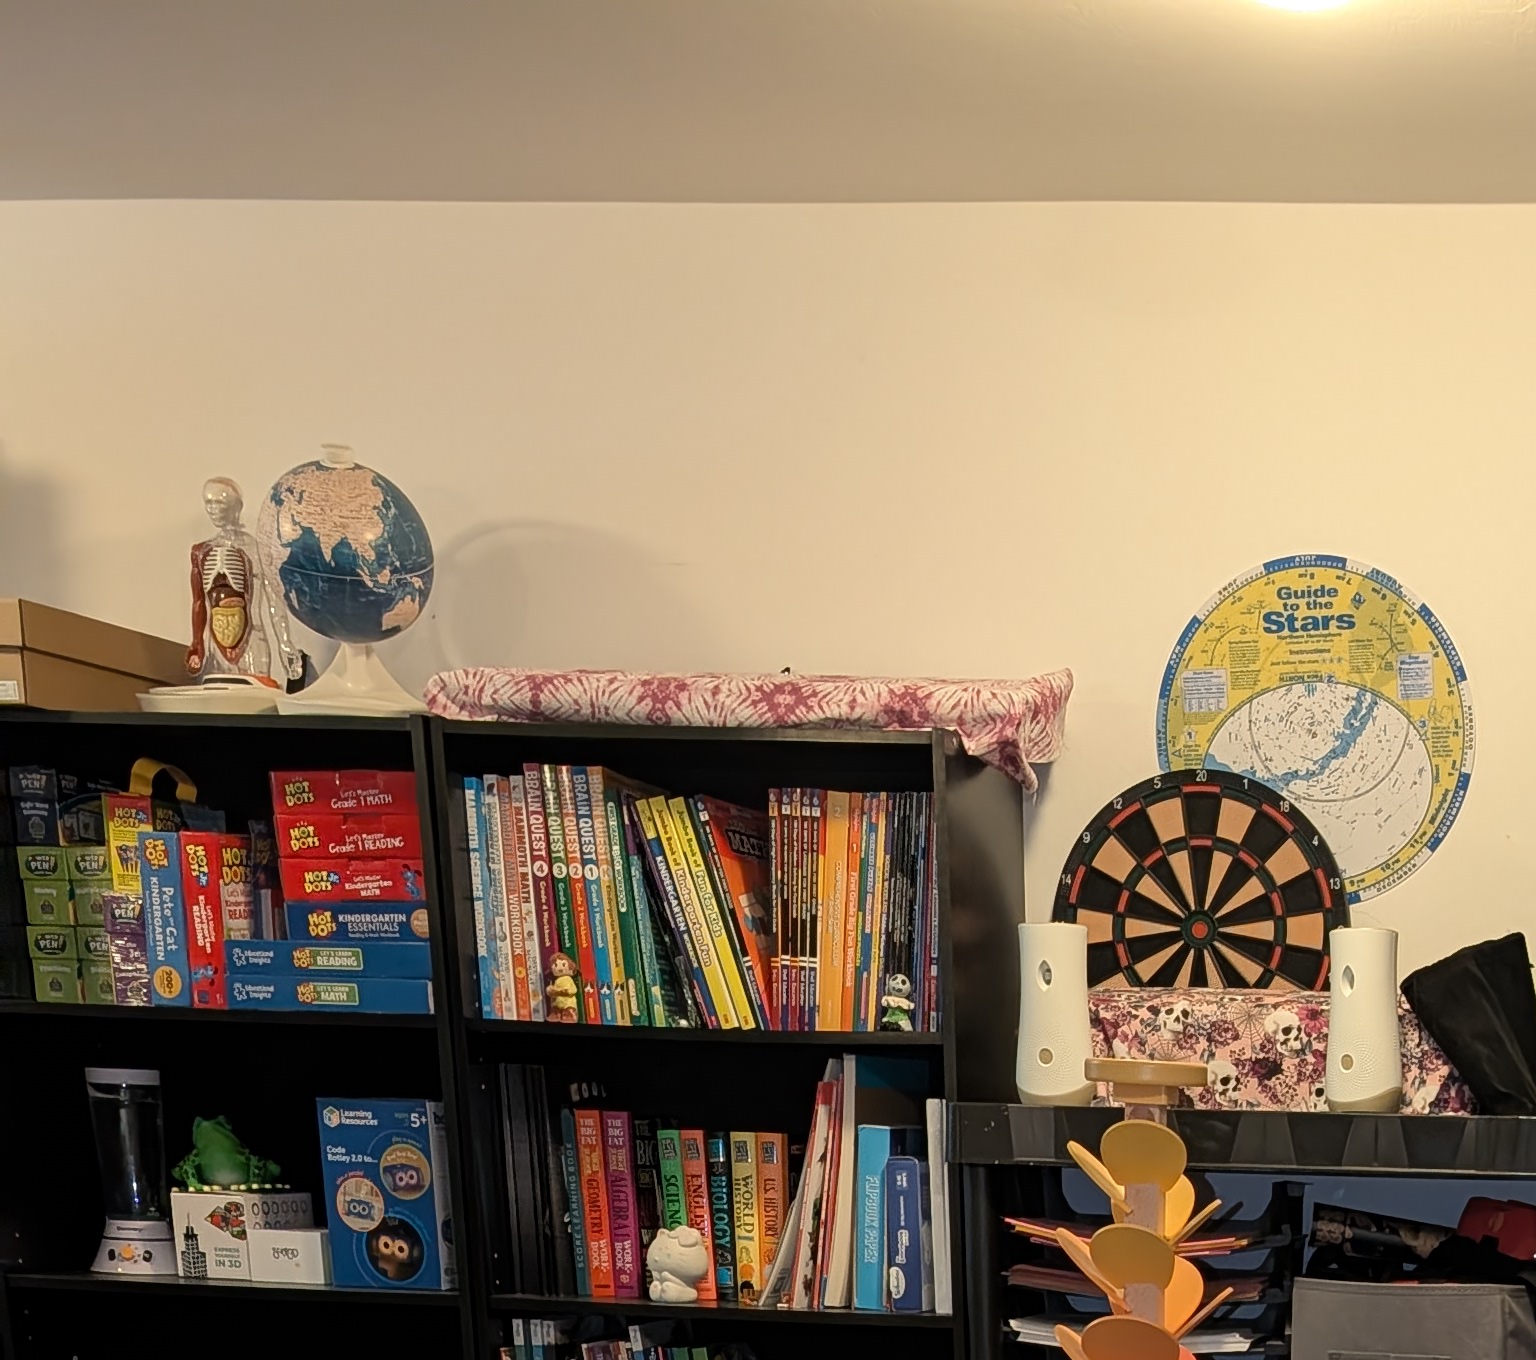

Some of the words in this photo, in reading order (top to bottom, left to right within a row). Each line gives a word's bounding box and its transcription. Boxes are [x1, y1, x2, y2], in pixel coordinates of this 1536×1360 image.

[1277, 586, 1338, 599] Guide
[1283, 602, 1299, 611] to
[1306, 600, 1334, 611] the
[1263, 611, 1355, 634] Stars
[1196, 770, 1207, 782] 20
[285, 781, 310, 795] HOT
[1154, 779, 1161, 789] 5
[1243, 779, 1248, 789] 1
[525, 770, 542, 813] BRAIN
[572, 774, 589, 817] BRAIN
[285, 793, 315, 806] DOTS
[1112, 798, 1123, 810] 12
[1279, 801, 1290, 812] 18
[290, 826, 315, 839] HOT
[529, 815, 547, 859] QUEST
[1083, 832, 1090, 844] 9
[290, 838, 319, 851] DOTS
[579, 821, 596, 861] QUEST
[1312, 836, 1318, 846] 4
[536, 864, 545, 874] 4
[588, 867, 593, 878] 1
[1061, 874, 1072, 886] 14
[1330, 879, 1340, 889] 13
[150, 876, 165, 961] KINDERGARTEN
[338, 914, 406, 922] KINDERGARTEN
[348, 922, 399, 932] ESSENTIALS
[317, 956, 357, 966] READING
[321, 992, 347, 1001] MATH
[340, 1108, 372, 1119] Learning
[340, 1116, 378, 1126] Resources
[409, 1113, 427, 1128] 5+
[607, 1118, 623, 1127] THE
[608, 1127, 624, 1137] BIG
[585, 1178, 604, 1239] GEOMETRY
[710, 1175, 730, 1250] BIOLOGY
